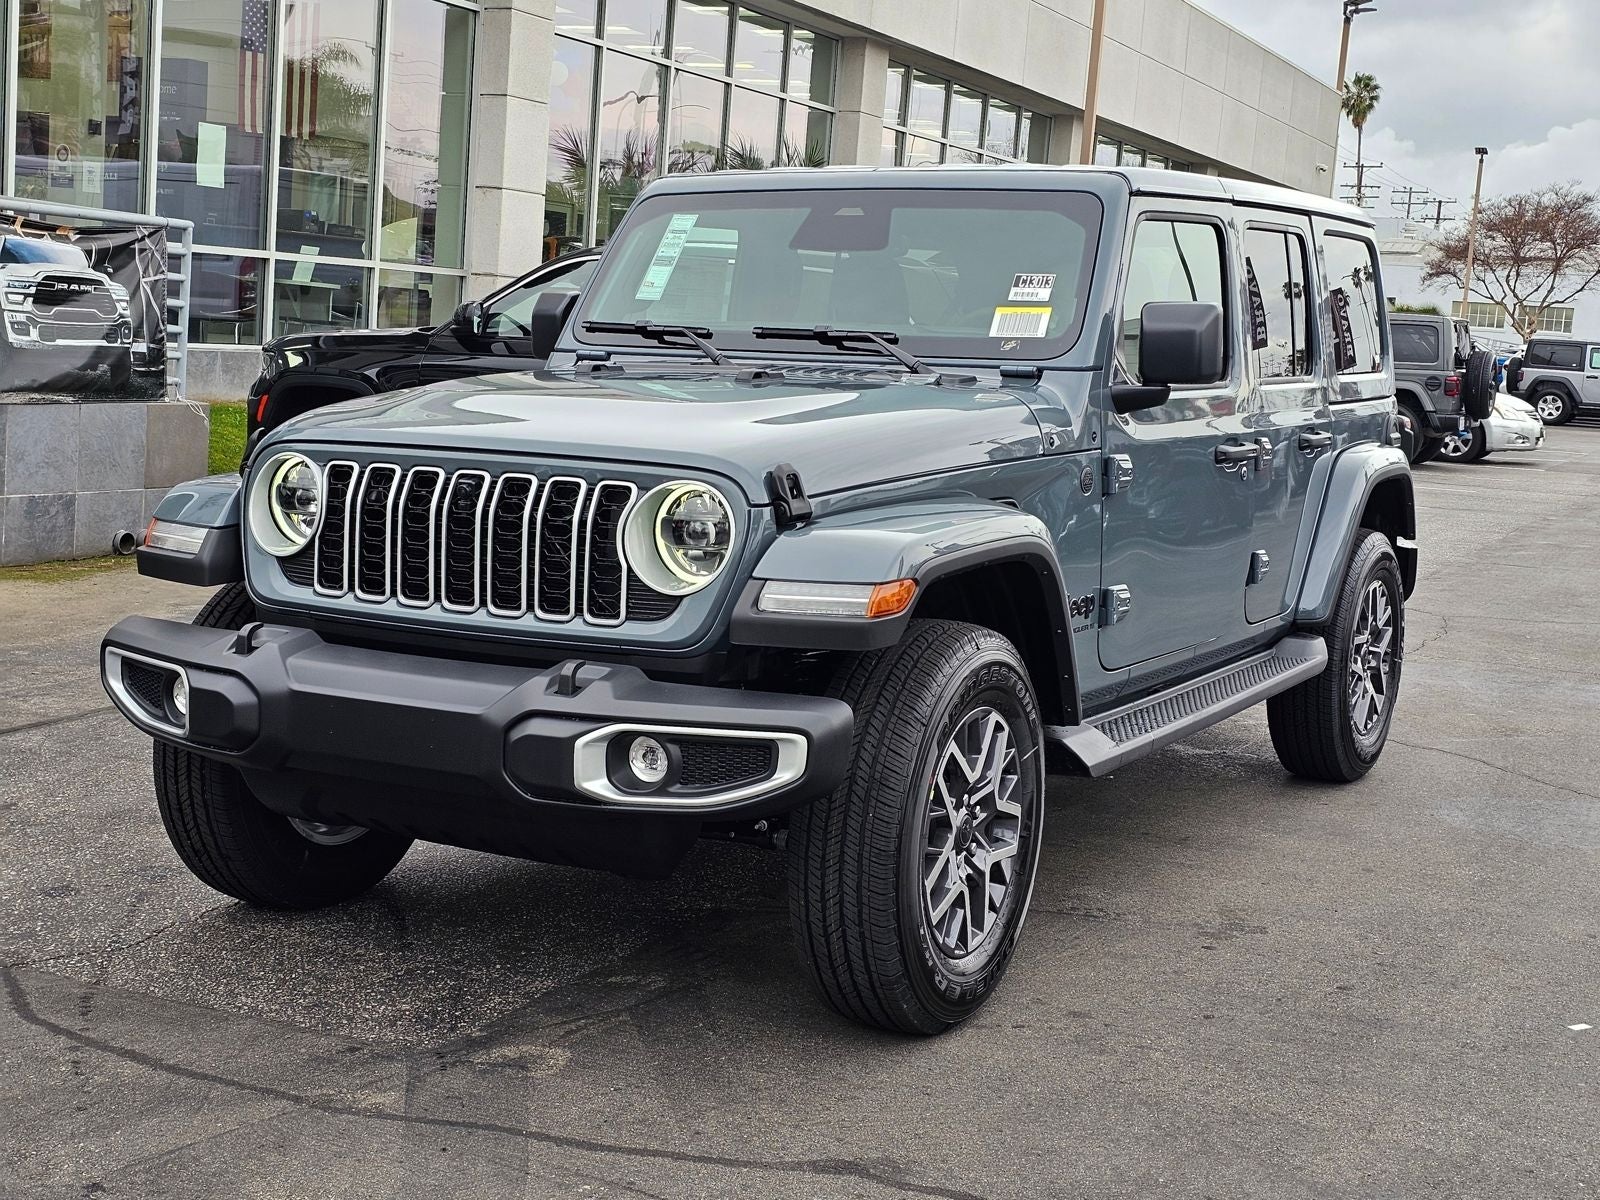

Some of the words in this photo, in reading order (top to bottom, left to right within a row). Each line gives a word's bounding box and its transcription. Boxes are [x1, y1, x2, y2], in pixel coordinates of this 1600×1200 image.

[57, 282, 92, 292] RAM
[1018, 275, 1053, 288] C13013
[1067, 593, 1096, 619] eep
